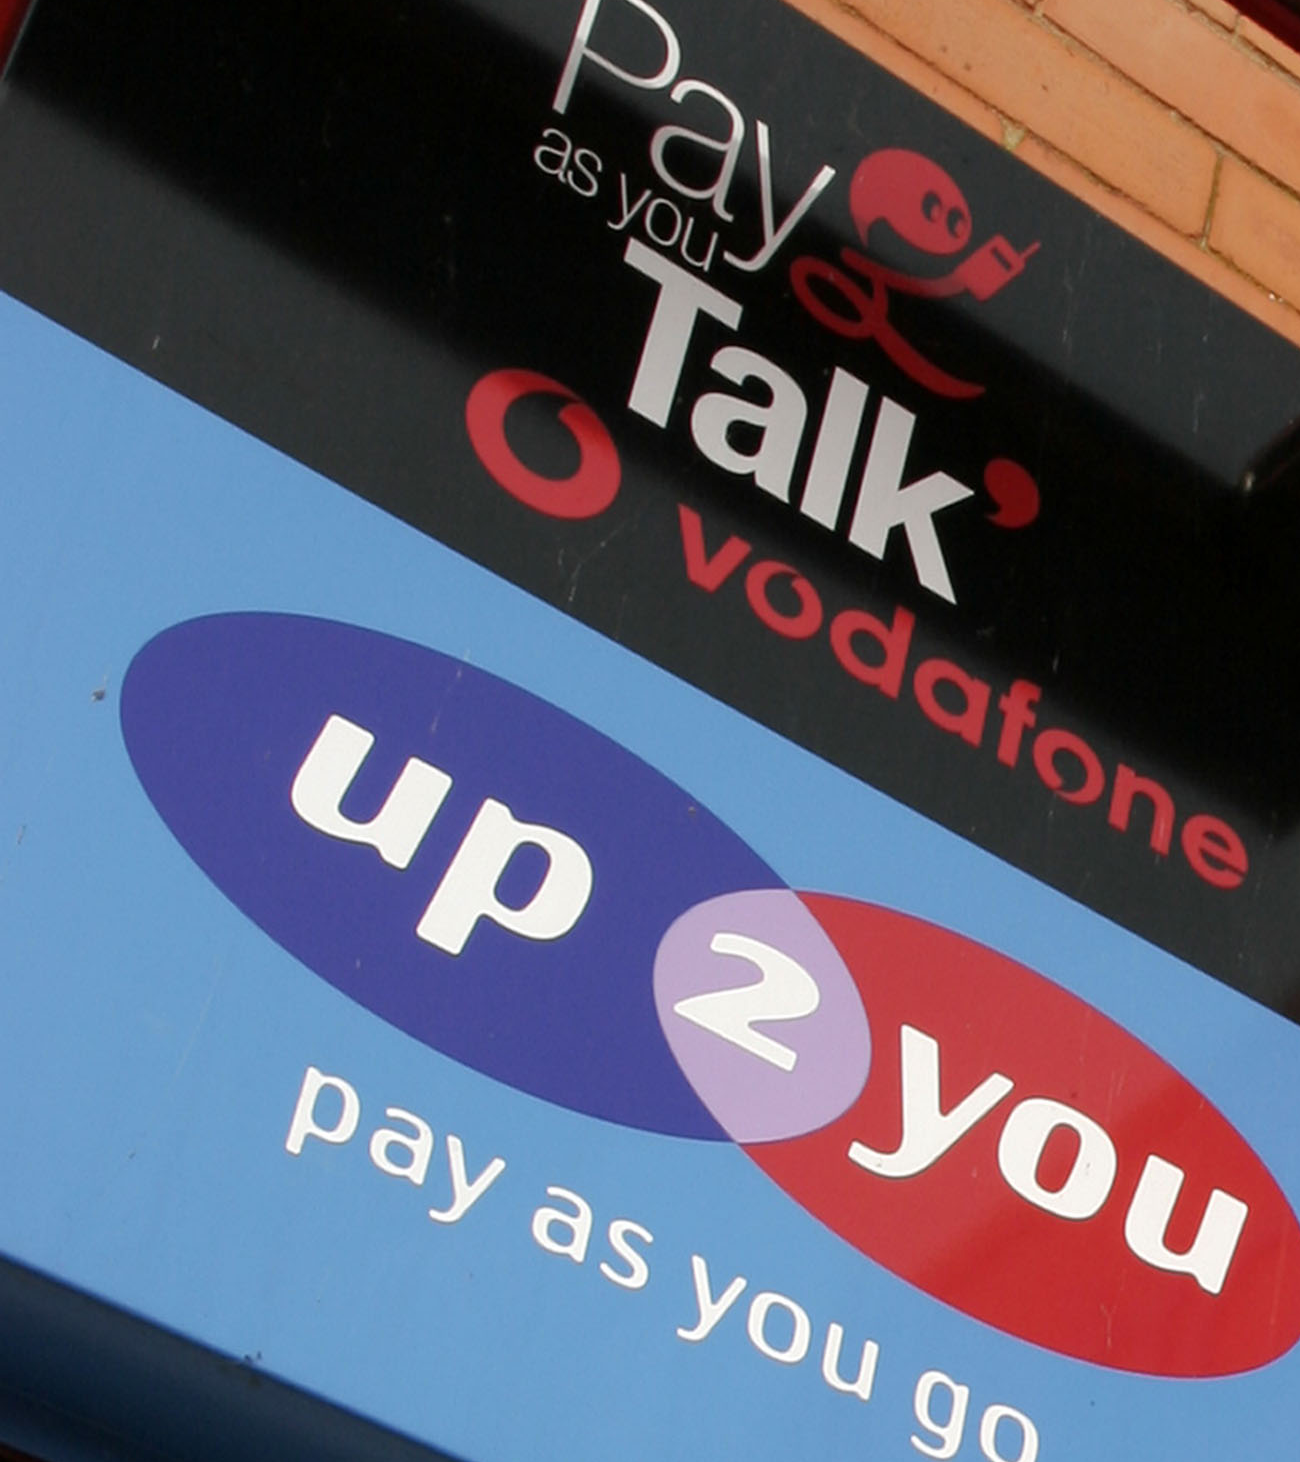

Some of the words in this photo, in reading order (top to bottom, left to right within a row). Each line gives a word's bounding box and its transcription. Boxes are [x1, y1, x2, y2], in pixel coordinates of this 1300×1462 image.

[533, 126, 602, 198] as
[607, 170, 721, 271] you
[624, 237, 974, 604] Talk
[677, 505, 1248, 889] vodafone
[285, 1066, 505, 1224] pay
[531, 1186, 652, 1290] as
[677, 1254, 880, 1400] you
